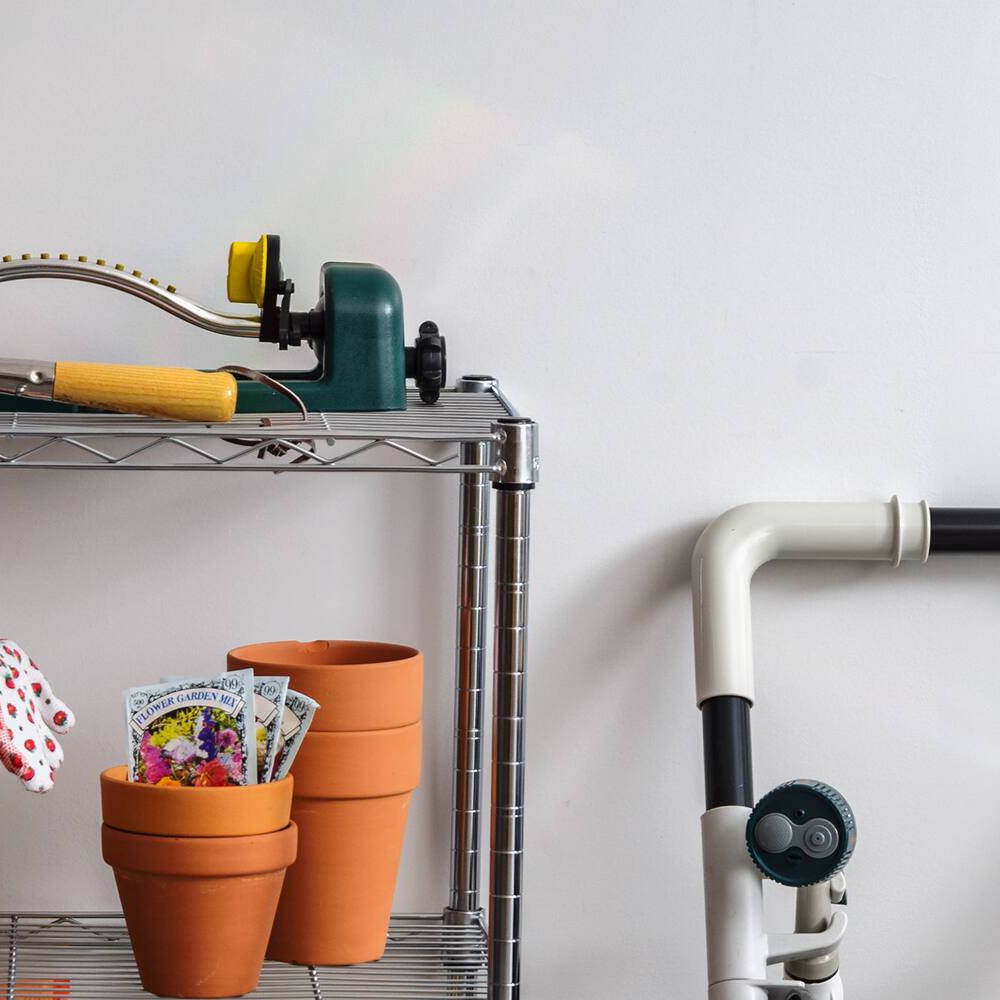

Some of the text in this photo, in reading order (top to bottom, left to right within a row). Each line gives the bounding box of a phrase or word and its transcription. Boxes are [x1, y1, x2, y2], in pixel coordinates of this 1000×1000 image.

[136, 691, 238, 725] FLOWER GARDEN MIX
